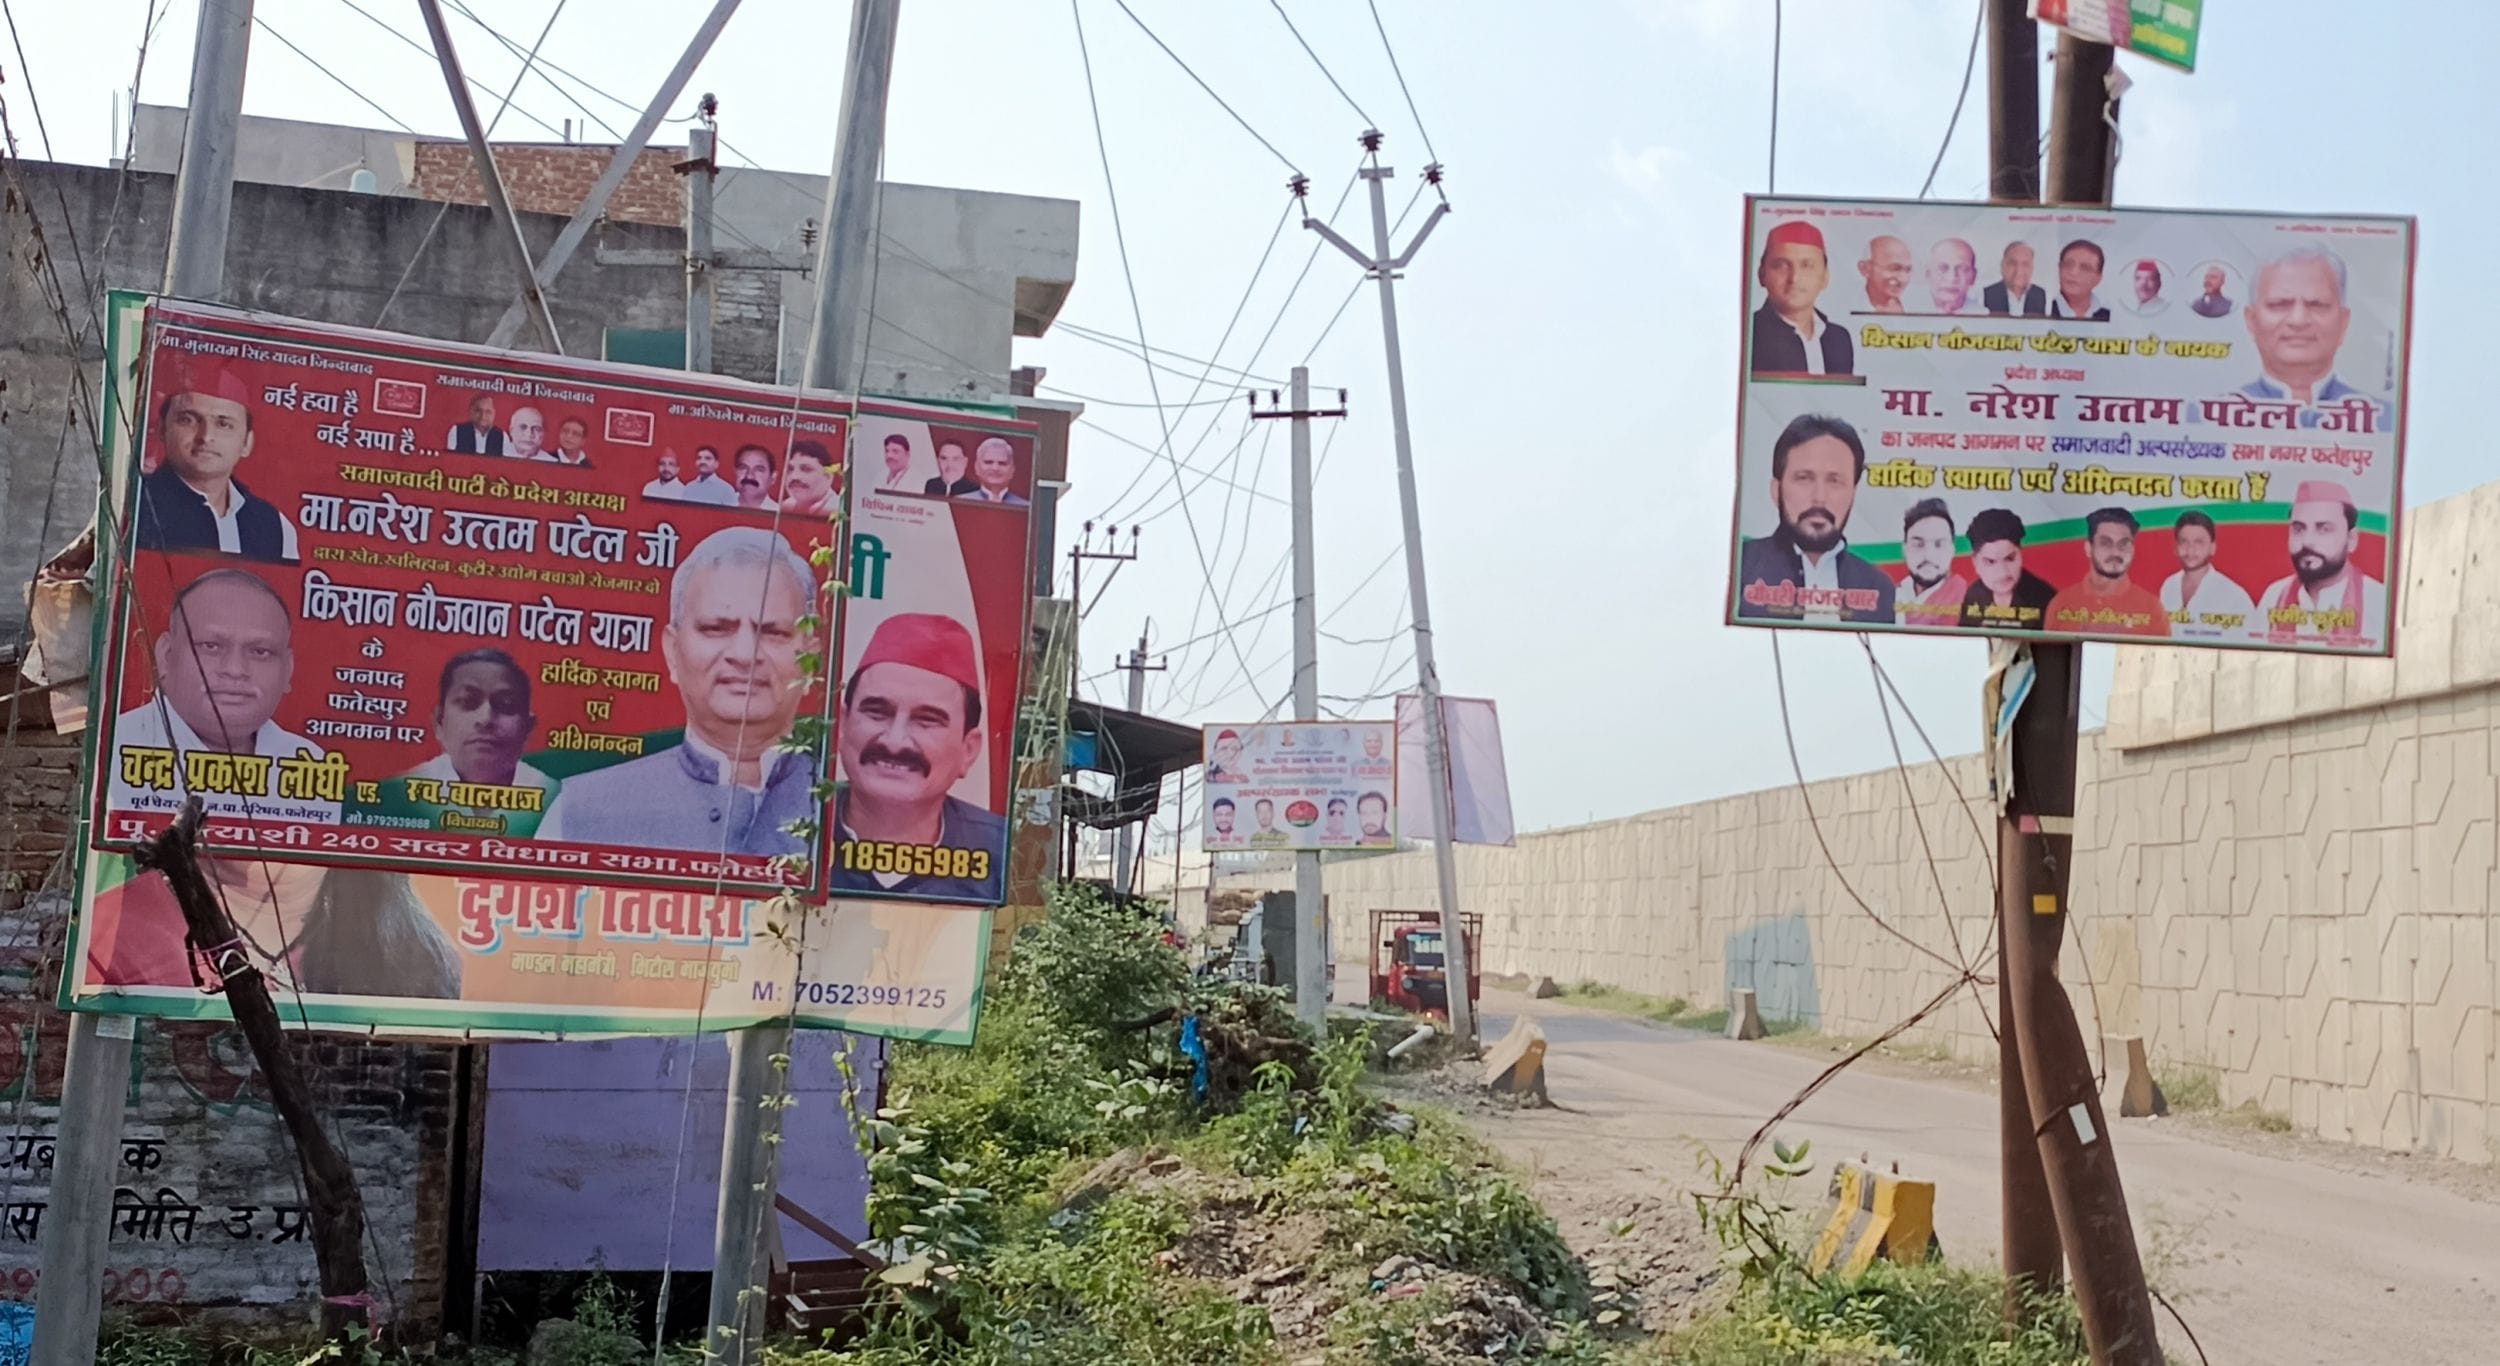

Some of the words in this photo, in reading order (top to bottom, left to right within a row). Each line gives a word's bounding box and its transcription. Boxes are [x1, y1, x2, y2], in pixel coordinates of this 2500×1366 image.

[1861, 324, 1933, 350] किसान
[1938, 326, 2023, 352] नौजवान
[2028, 325, 2081, 354] पटेल
[2083, 337, 2131, 356] यात्रा
[2137, 330, 2159, 357] के
[2166, 340, 2232, 359] नायक
[242, 343, 270, 362] सिंह
[272, 353, 306, 367] यादव
[310, 353, 374, 375] जिन्दाबाद
[264, 382, 299, 411] नई
[301, 390, 339, 413] हवा
[342, 390, 360, 417] है
[436, 374, 504, 393] समाजवादी
[506, 381, 532, 396] पार्टी
[534, 385, 596, 404] जिन्दाबाद
[746, 415, 778, 427] यादव
[1881, 389, 1943, 417] मा.
[1966, 384, 2059, 420] नरेश
[2075, 394, 2184, 425] उत्तम
[2200, 393, 2302, 430] पटेल
[2317, 399, 2380, 433] जी
[317, 420, 351, 448] नई
[354, 428, 395, 451] सपा
[1881, 431, 1902, 447] का
[1907, 432, 1956, 449] जनपद
[1961, 434, 2021, 450] आगमन
[2025, 435, 2046, 452] पर
[2052, 432, 2132, 456] समाजवादी
[2137, 435, 2227, 460] अल्पसंख्यक
[2232, 443, 2265, 462] सभा
[2269, 445, 2308, 464] नगर
[2311, 446, 2374, 476] फतेहपुर
[339, 463, 443, 493] समाजवादी
[447, 474, 485, 496] पार्टी
[489, 475, 510, 498] के
[513, 481, 560, 504] प्रदेश
[564, 490, 627, 512] अध्यक्ष
[1866, 458, 1937, 488] हार्दिक
[1942, 465, 2014, 491] स्वागत
[2019, 462, 2058, 492] एवं
[2180, 474, 2242, 502] करता
[299, 492, 434, 544] मा.नरेश
[441, 508, 539, 553] उत्तम
[548, 514, 628, 566] पटेल
[636, 522, 680, 568] जी
[302, 569, 399, 627] किसान
[405, 583, 511, 638] नौजवान
[520, 595, 583, 646] पटेल
[590, 612, 653, 653] यात्रा
[361, 636, 383, 659] के
[335, 667, 405, 688] जनपद
[540, 659, 598, 686] हार्दिक
[603, 669, 661, 692] स्वागत
[328, 690, 408, 720] फतेहपुर
[586, 695, 613, 720] एवं
[306, 719, 391, 741] आगमन
[396, 723, 425, 744] पर
[548, 724, 644, 755] अभिनन्दन
[120, 745, 175, 791] चन्द्र
[185, 749, 272, 794] प्रकाश
[201, 825, 312, 846] त्याशी
[322, 833, 379, 850] 240
[390, 837, 472, 856] सदर
[480, 839, 591, 866] विधान
[829, 840, 990, 880] 18565983
[752, 980, 784, 1002] M:
[795, 982, 946, 1009] 7052399125
[110, 1187, 202, 1244] मिति
